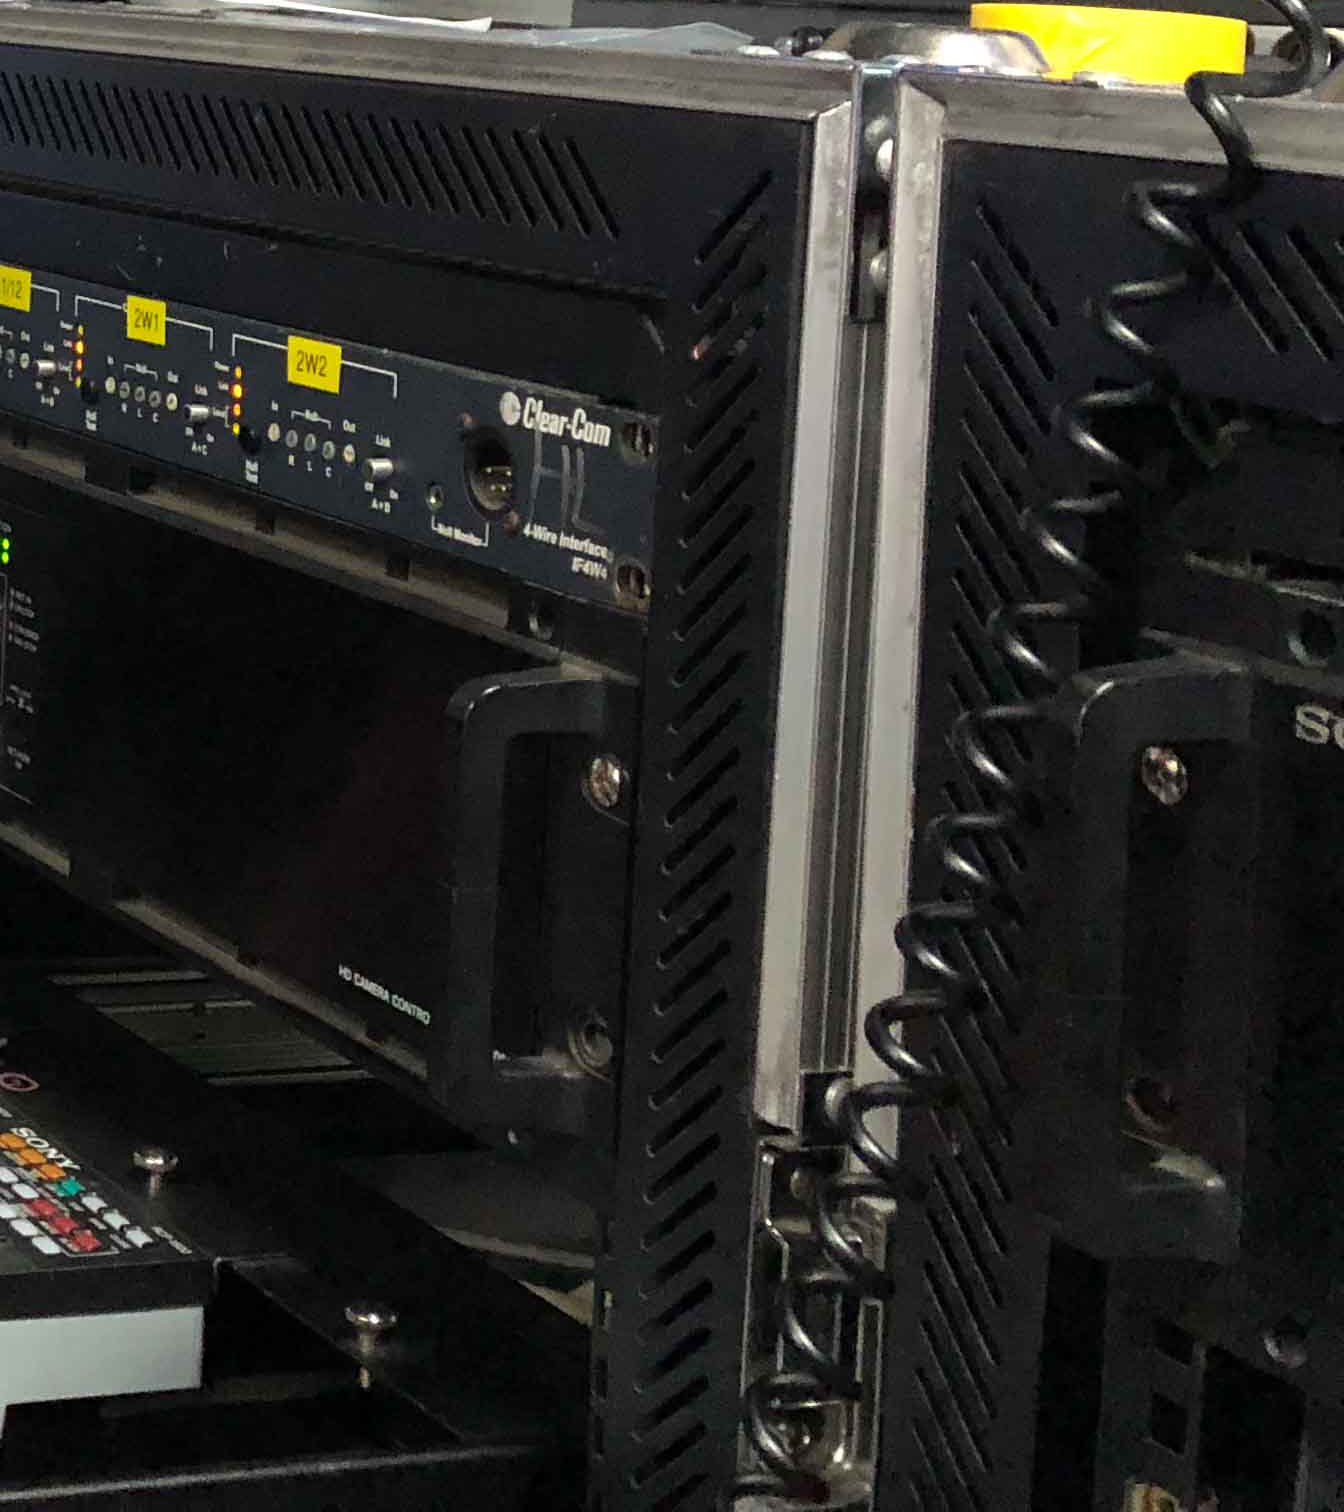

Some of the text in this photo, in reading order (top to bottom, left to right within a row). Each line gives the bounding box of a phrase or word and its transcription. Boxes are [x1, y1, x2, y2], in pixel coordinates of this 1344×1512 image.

[134, 307, 160, 333] 2W1
[296, 349, 328, 378] 2W2
[522, 396, 611, 448] Clear-Com
[523, 521, 609, 559] 4-Wire Interface
[353, 971, 390, 1002] CAMERA
[9, 1127, 81, 1170] SONY
